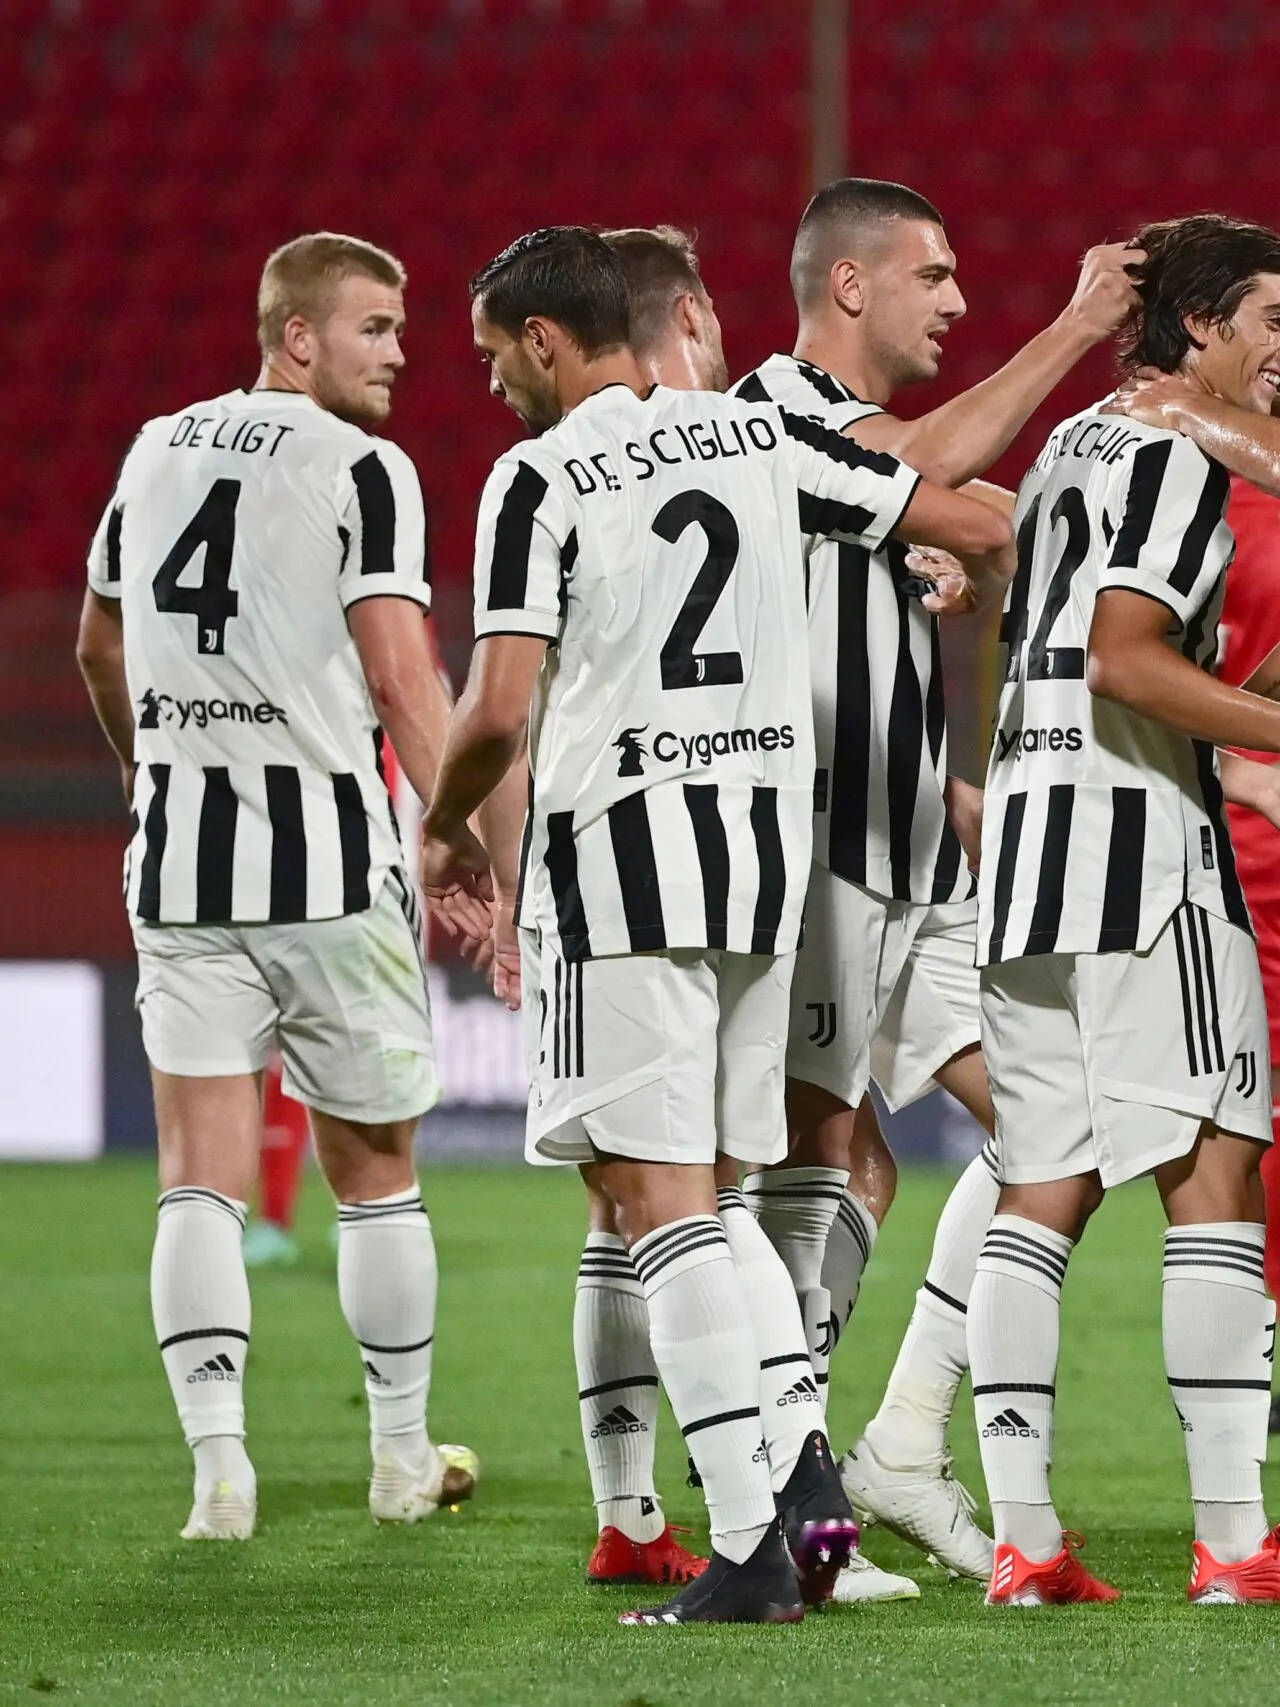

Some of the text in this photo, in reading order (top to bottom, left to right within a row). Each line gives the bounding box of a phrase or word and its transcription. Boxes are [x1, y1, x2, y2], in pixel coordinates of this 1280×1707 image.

[168, 415, 295, 457] DE LIGT
[563, 417, 778, 496] DE SCIGLIO
[152, 478, 243, 656] 4
[651, 488, 744, 691] 2
[998, 486, 1085, 683] 42
[652, 723, 796, 768] Cygames
[590, 1421, 648, 1440] adidas
[981, 1426, 1041, 1439] adidas
